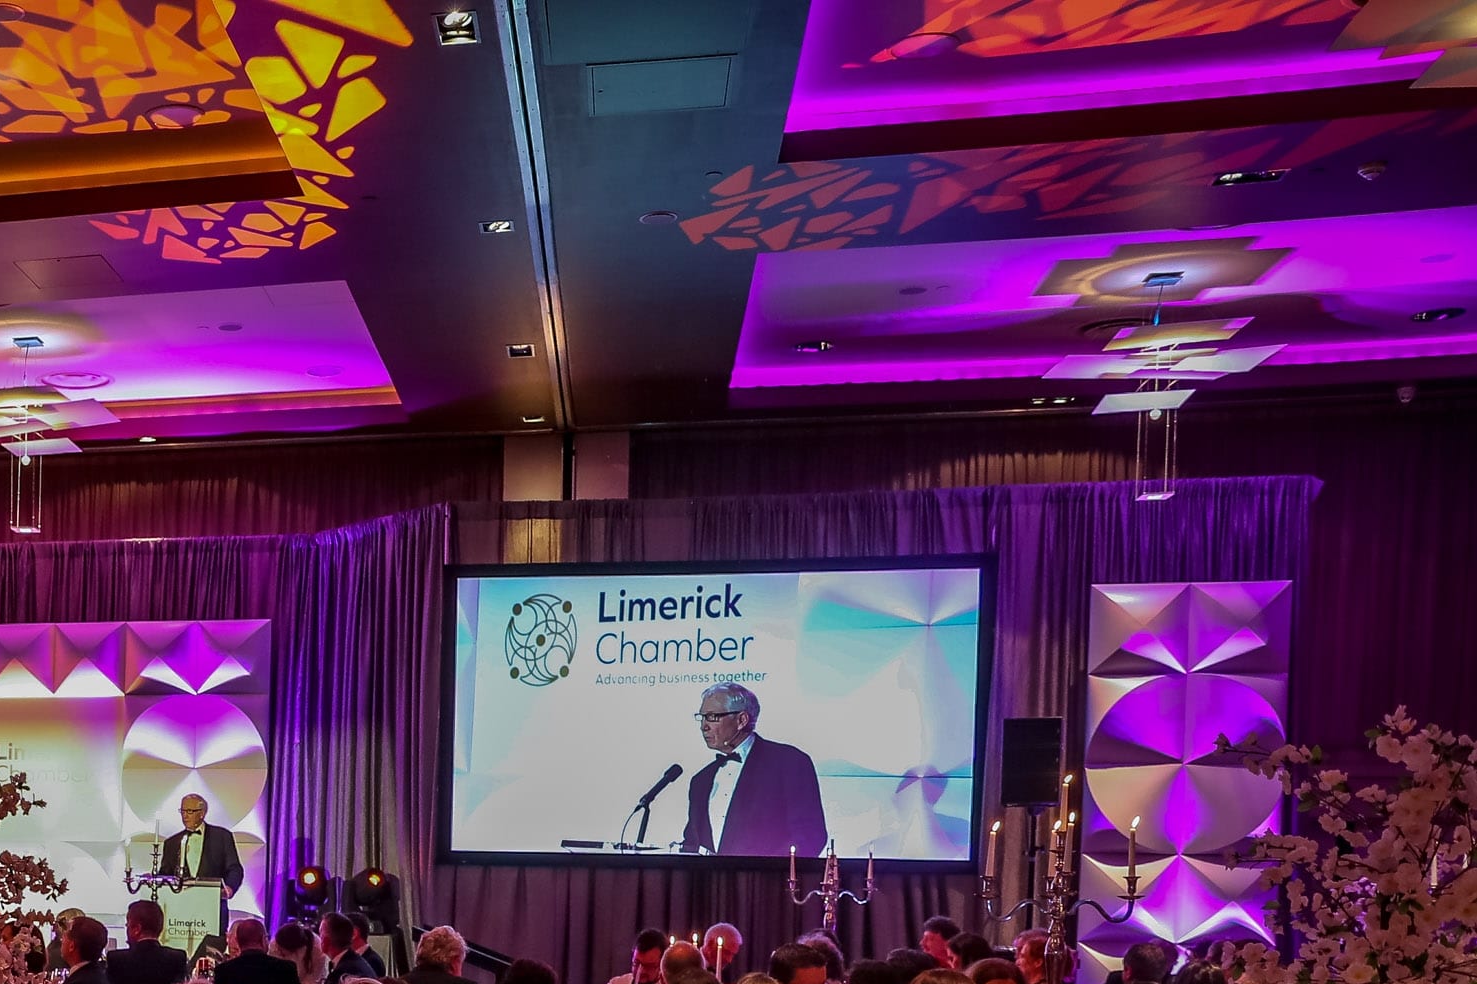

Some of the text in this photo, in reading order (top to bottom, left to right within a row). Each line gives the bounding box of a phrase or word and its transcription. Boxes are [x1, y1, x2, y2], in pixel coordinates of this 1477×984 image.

[598, 583, 743, 623] Limerick
[596, 628, 754, 665] Chamber
[596, 670, 767, 687] Advancing business together
[168, 919, 207, 928] Limerick
